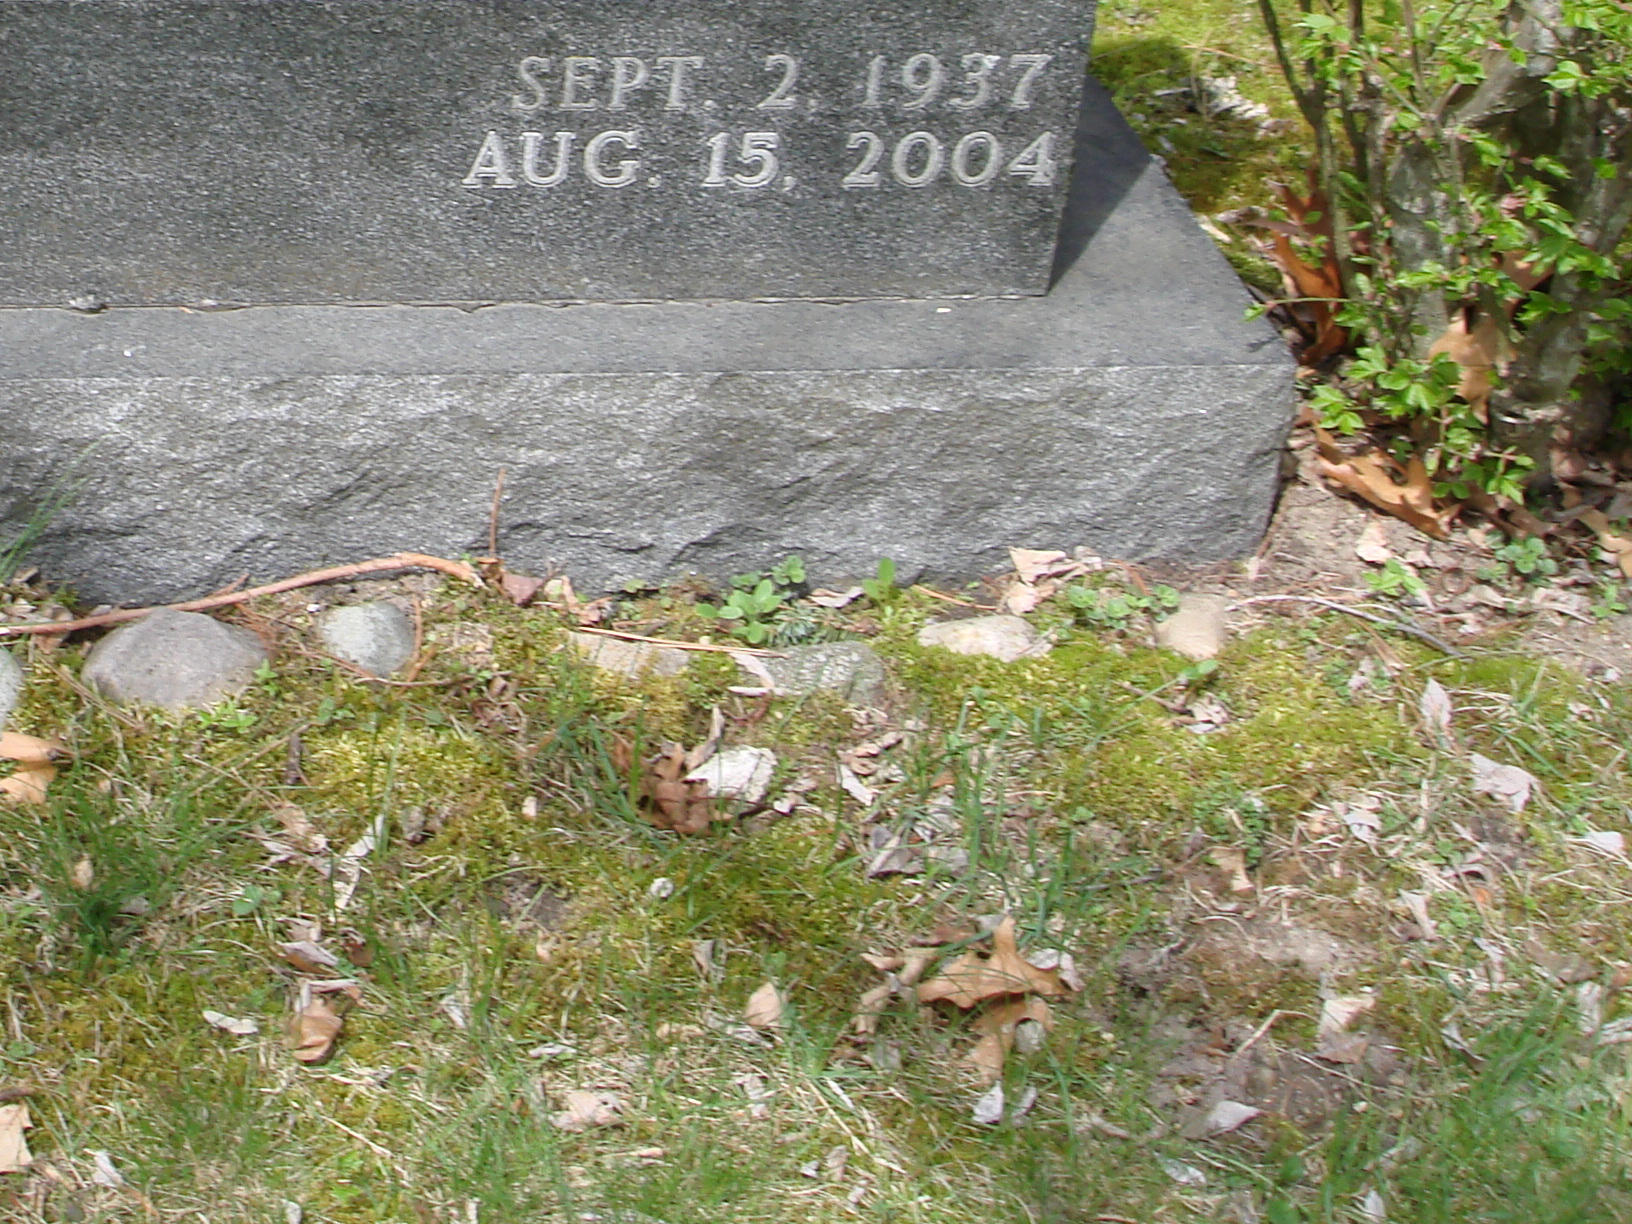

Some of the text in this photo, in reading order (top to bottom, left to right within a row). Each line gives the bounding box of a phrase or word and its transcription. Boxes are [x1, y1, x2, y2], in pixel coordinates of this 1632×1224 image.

[511, 54, 719, 112] SEPT.
[865, 51, 1054, 111] 1937
[460, 129, 1056, 192] AUG. 15, 2004
